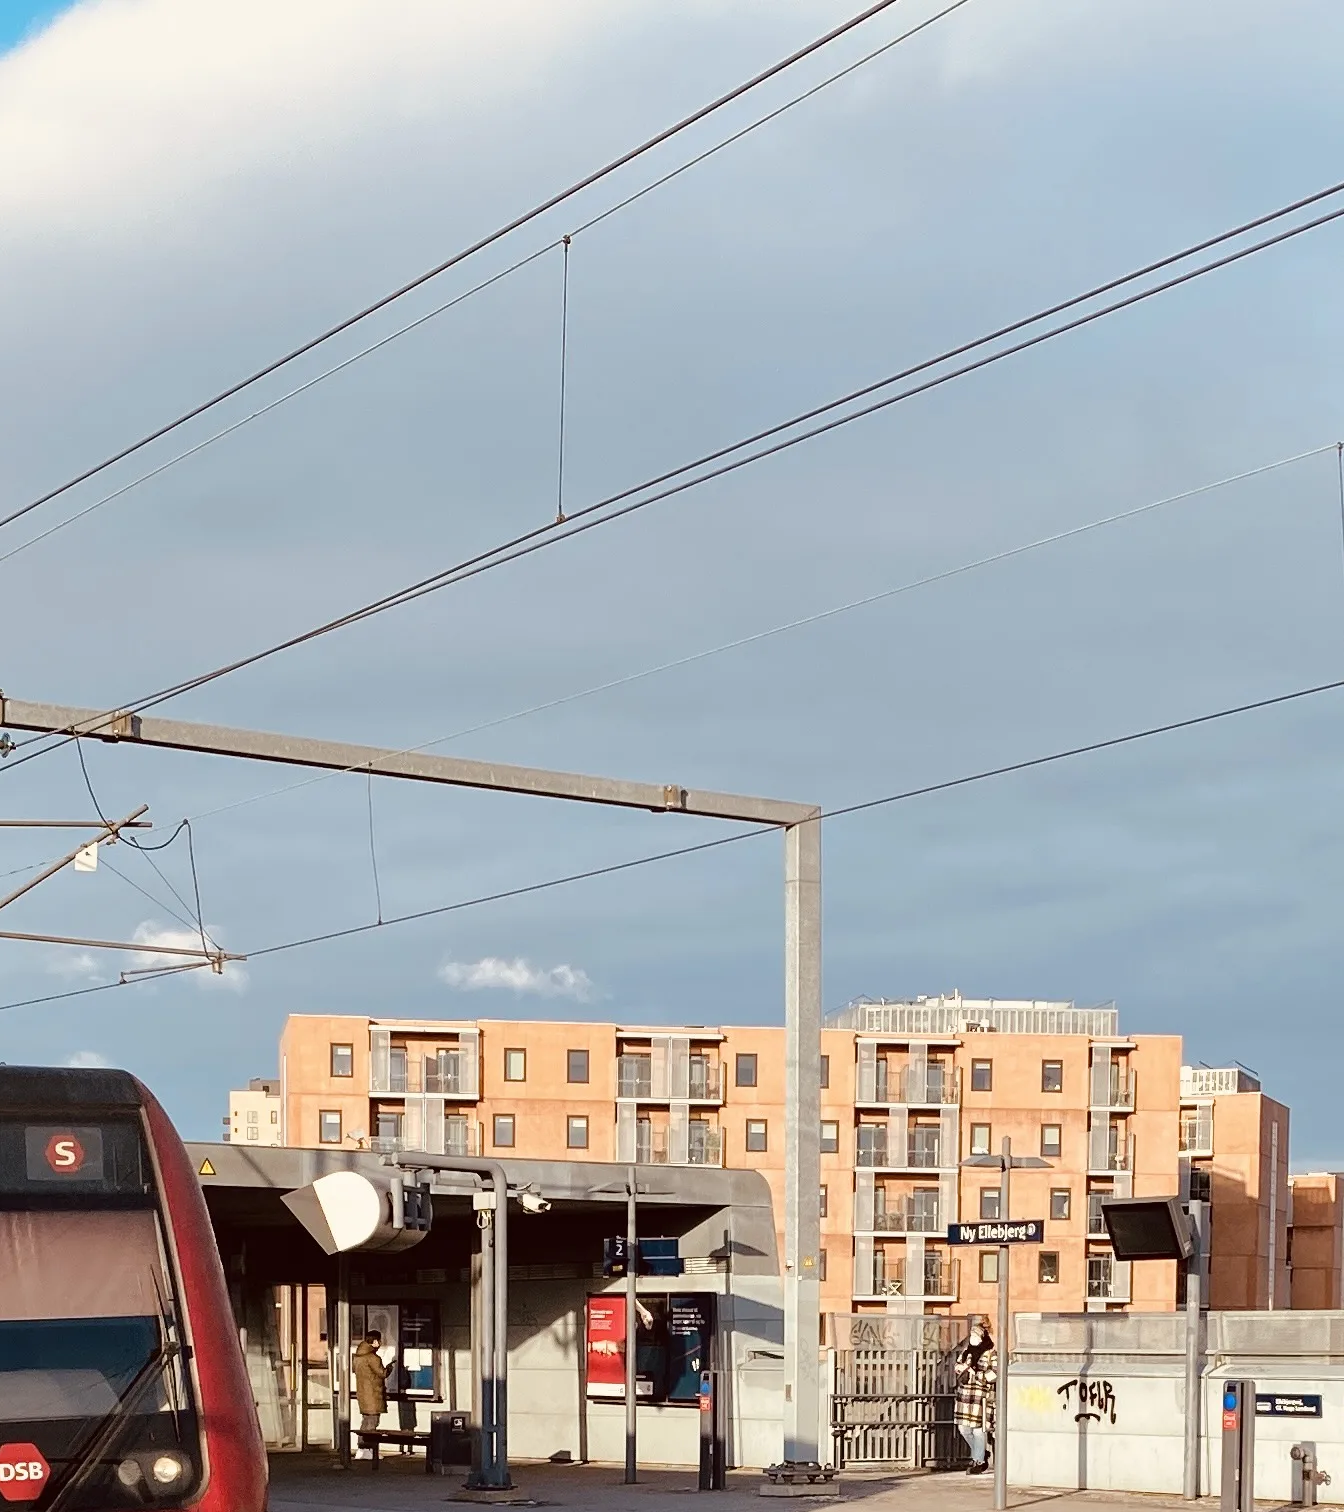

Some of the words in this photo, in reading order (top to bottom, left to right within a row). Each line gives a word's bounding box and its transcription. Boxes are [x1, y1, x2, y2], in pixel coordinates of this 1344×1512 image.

[55, 1141, 75, 1166] S
[960, 1226, 976, 1243] Ny
[978, 1223, 1027, 1241] Ellebjerg
[616, 1243, 624, 1257] 2
